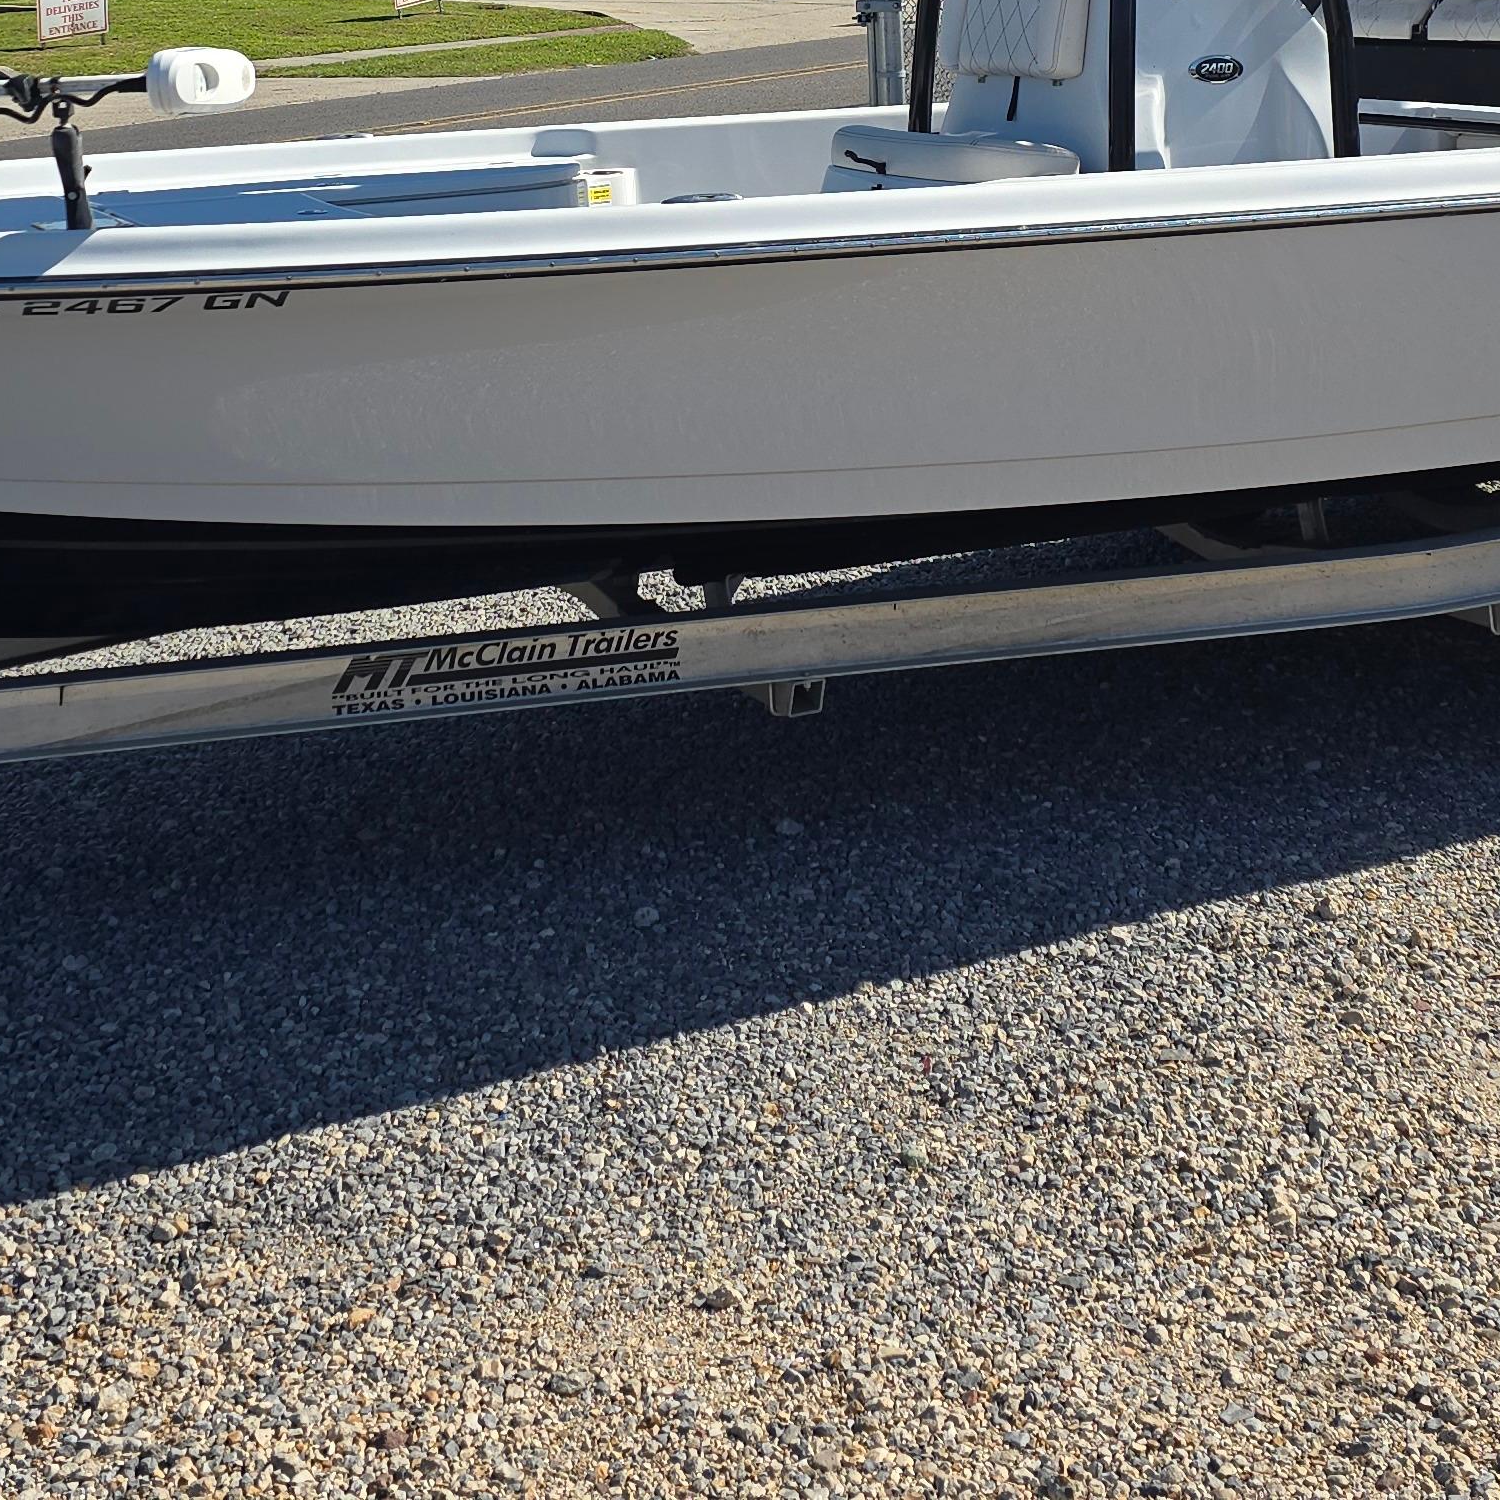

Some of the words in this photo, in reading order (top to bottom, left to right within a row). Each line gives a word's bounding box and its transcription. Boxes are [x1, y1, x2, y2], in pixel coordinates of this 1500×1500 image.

[46, 0, 99, 16] DELIVERIES
[62, 13, 84, 23] THIS
[49, 21, 98, 35] ENTRANCE
[1200, 63, 1234, 74] 2400
[22, 296, 185, 315] 2467
[203, 291, 290, 310] GN
[424, 638, 557, 672] McClain
[567, 629, 678, 658] Trailers
[411, 681, 457, 695] FOR
[463, 677, 504, 689] THE
[511, 669, 591, 685] LONG
[332, 699, 405, 716] TEXAS
[431, 683, 552, 706] LOUISIANA
[576, 669, 681, 691] ALABAMA
